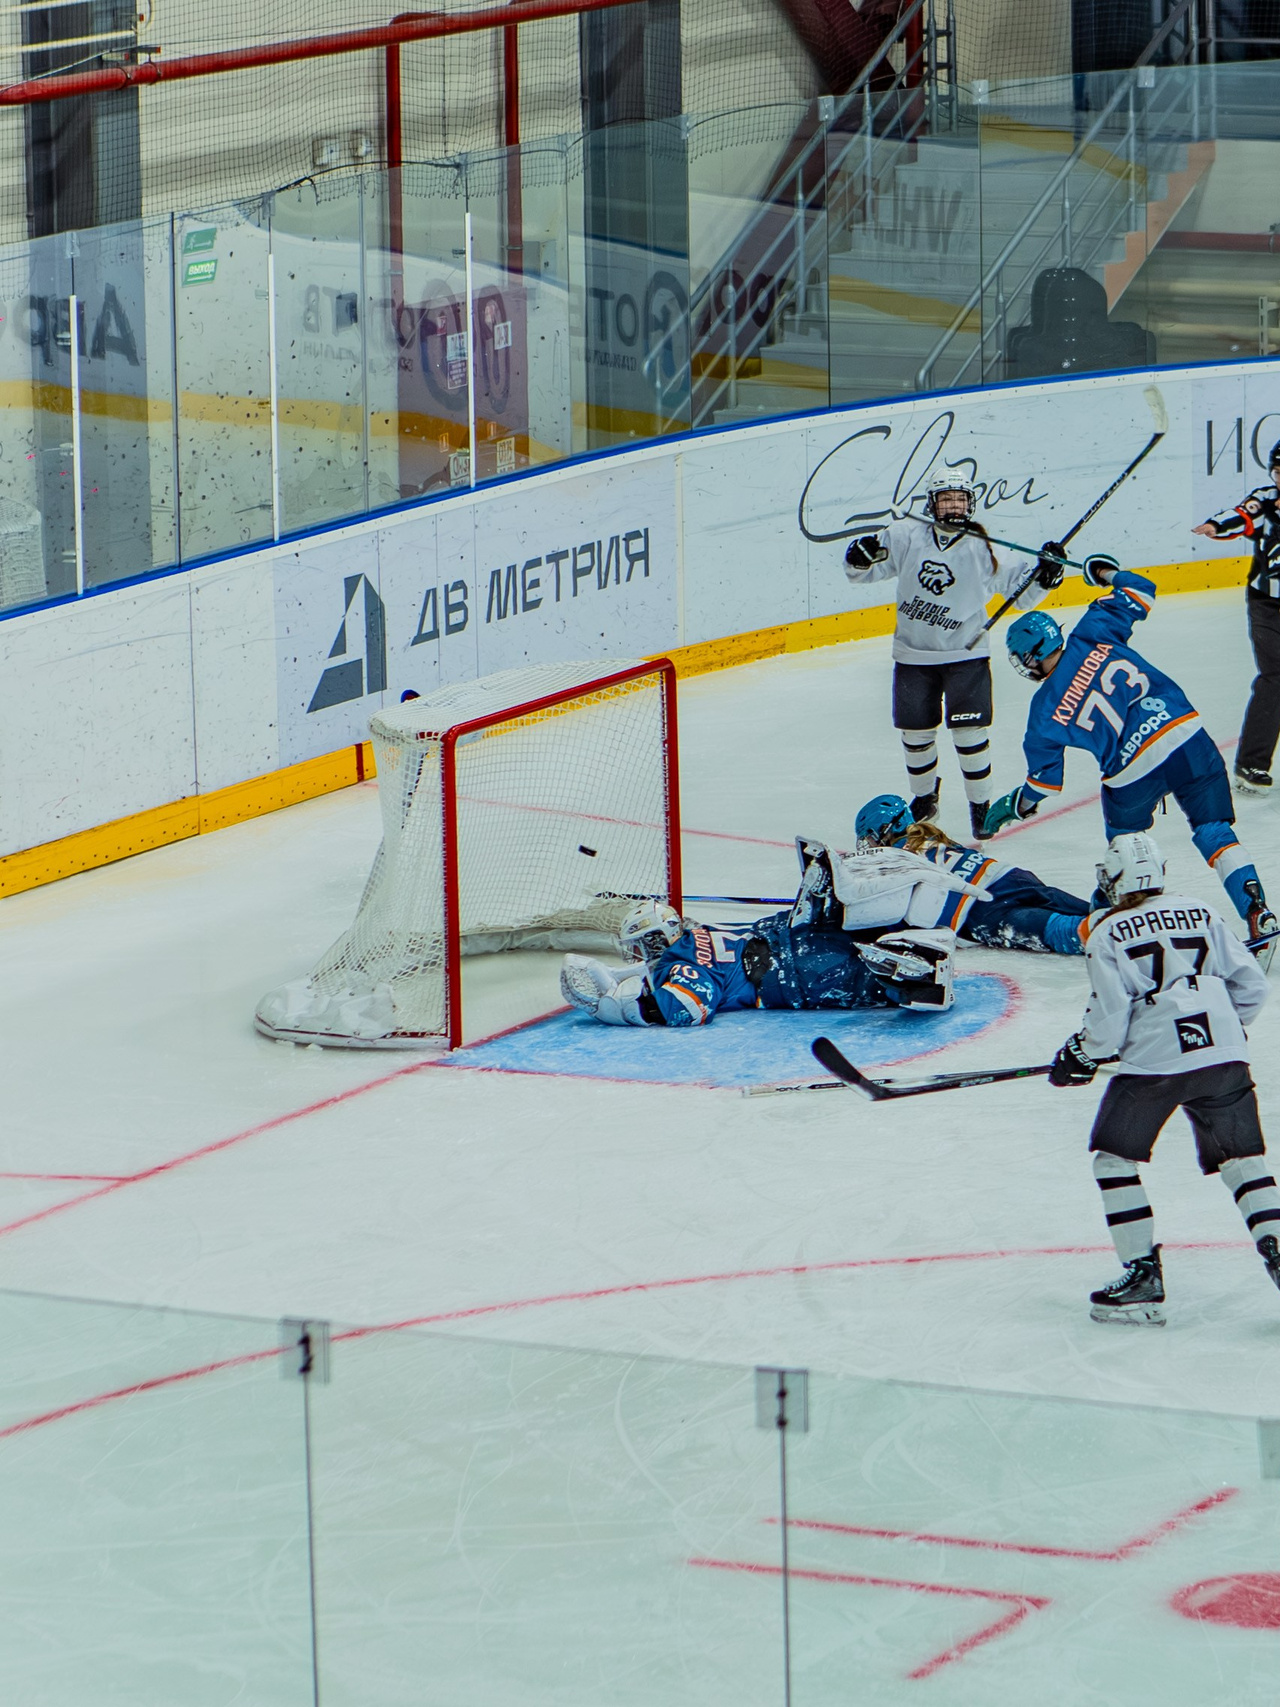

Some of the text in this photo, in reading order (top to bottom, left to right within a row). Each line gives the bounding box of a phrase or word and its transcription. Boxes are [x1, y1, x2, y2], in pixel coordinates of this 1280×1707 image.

[410, 527, 650, 646] ДВ МЕТРИЯ
[950, 711, 982, 721] CCM
[1052, 642, 1114, 727] КУЛИШОВА
[1075, 659, 1151, 739] 73
[1120, 709, 1173, 767] Аврора
[1135, 874, 1151, 890] 77
[1123, 936, 1210, 1006] 77
[1180, 1031, 1205, 1047] ТМК
